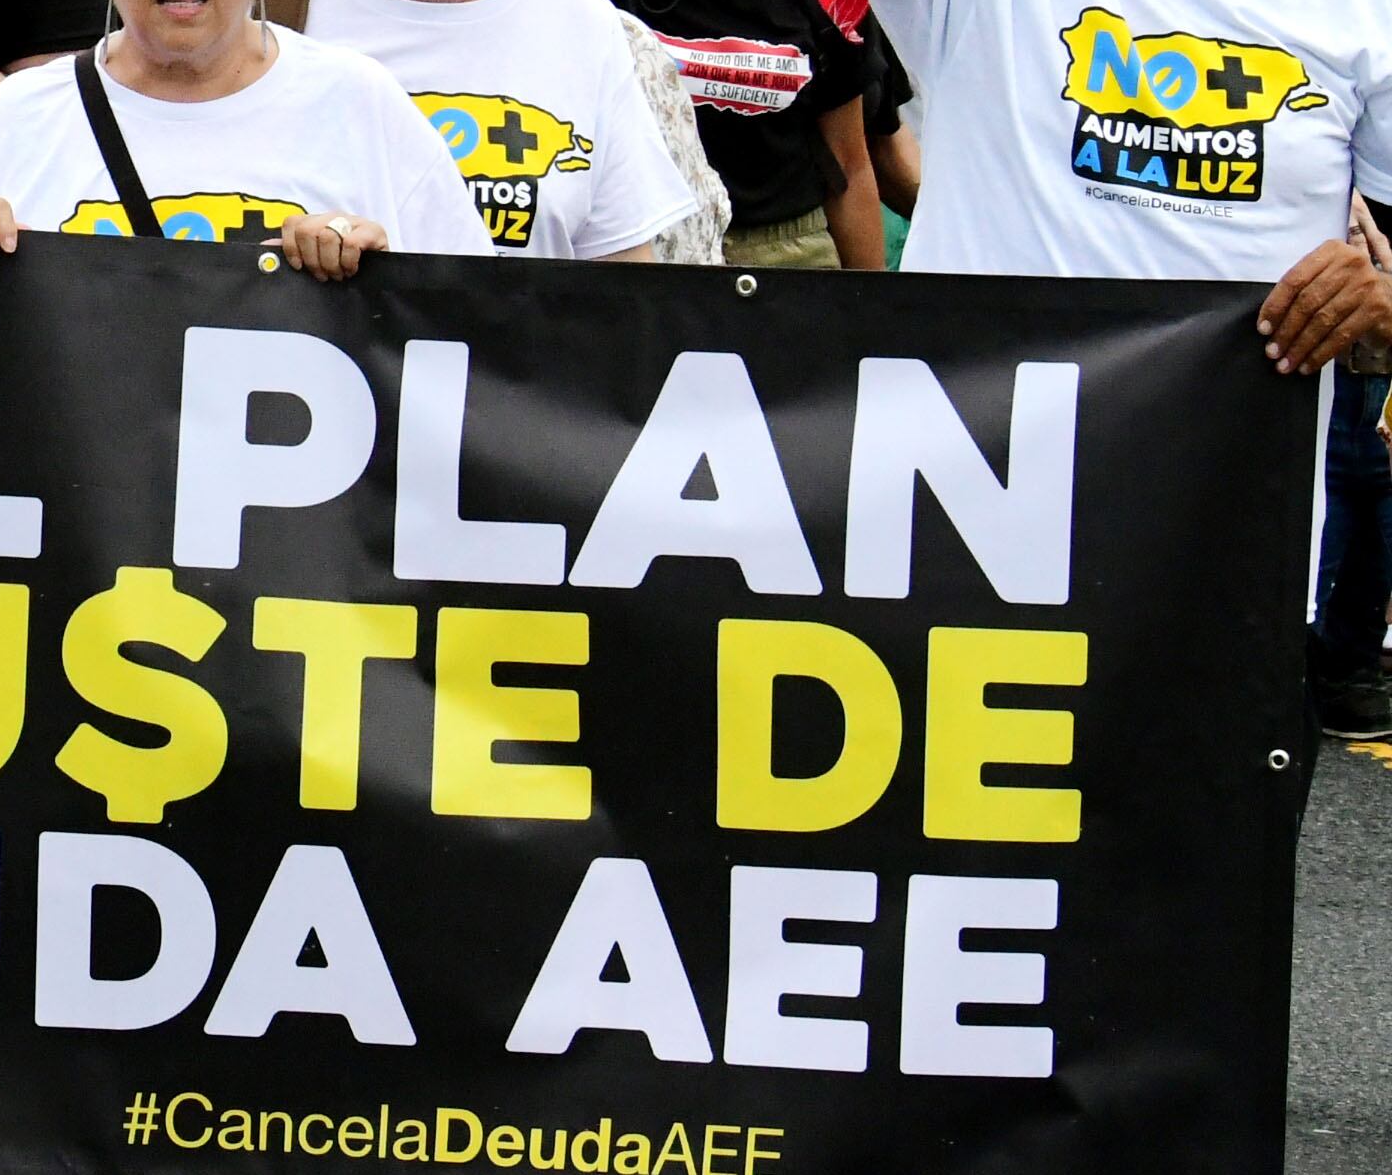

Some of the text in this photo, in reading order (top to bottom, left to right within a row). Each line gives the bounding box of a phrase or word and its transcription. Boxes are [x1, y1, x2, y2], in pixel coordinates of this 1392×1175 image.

[686, 63, 768, 86] CON QUE NO ME
[689, 51, 772, 70] NO PIDO QUE ME
[704, 82, 780, 106] ES SUFICIENTE
[1080, 114, 1257, 159] AUMENTO$
[1074, 139, 1257, 194] A LA LUZ
[1085, 186, 1234, 218] #CancelaDeudaAEE
[172, 326, 1080, 605] PLAN
[716, 618, 1088, 842] DE
[505, 857, 1059, 1078] AEE
[123, 1091, 785, 1175] #CancelaDeudaAEE
